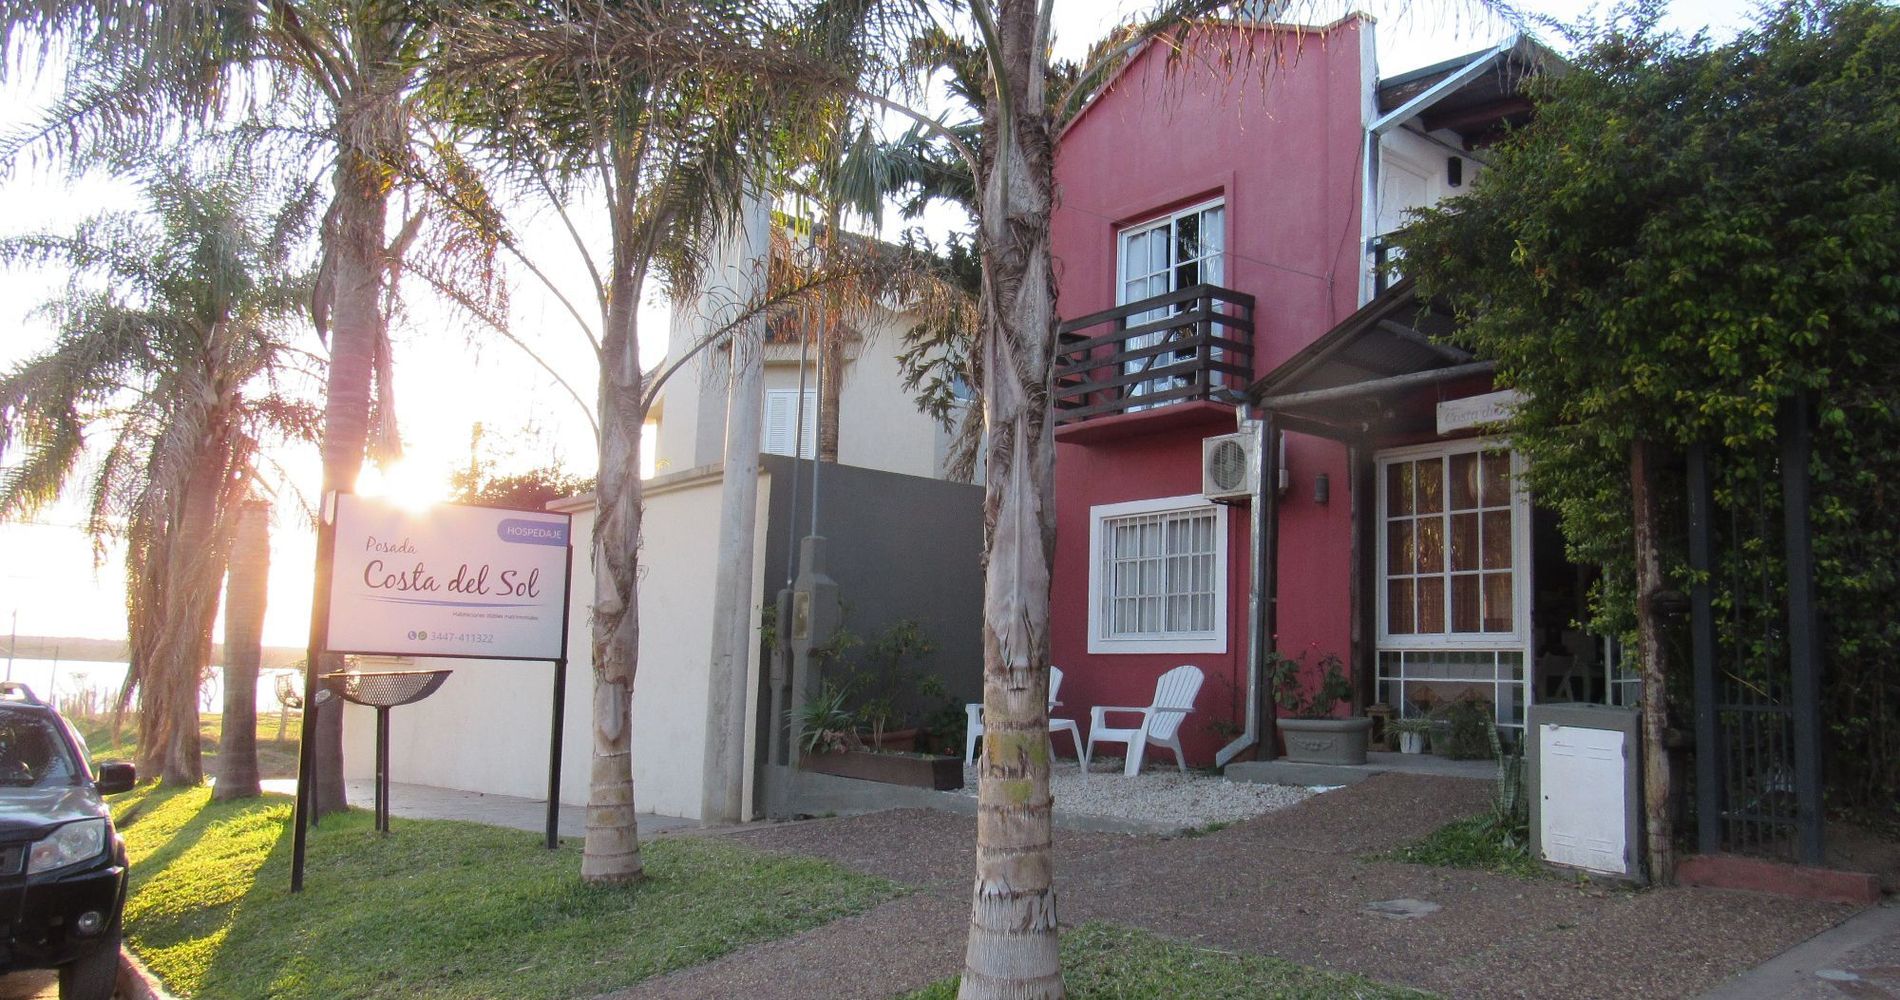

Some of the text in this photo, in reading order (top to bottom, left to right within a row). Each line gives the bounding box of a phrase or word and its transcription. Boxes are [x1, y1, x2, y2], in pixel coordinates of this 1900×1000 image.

[507, 526, 562, 539] HOSPEDAJE
[366, 536, 416, 555] Posada
[363, 560, 540, 598] Costa del Sol
[430, 631, 494, 643] 3447-411322
